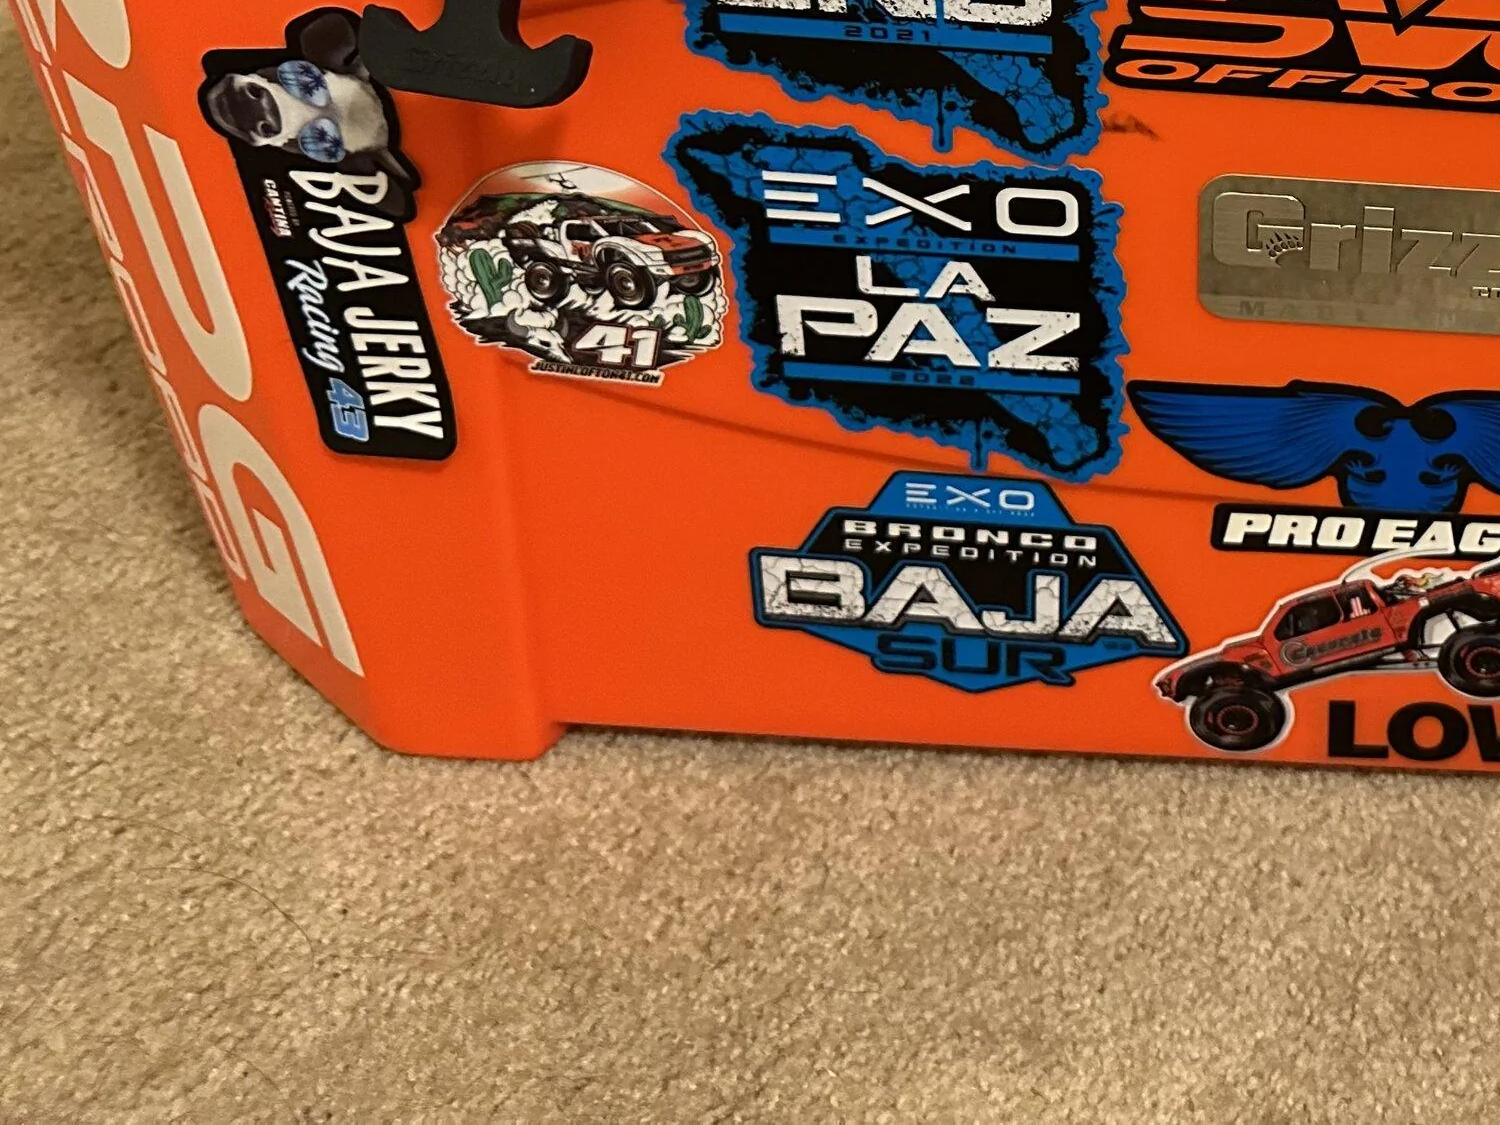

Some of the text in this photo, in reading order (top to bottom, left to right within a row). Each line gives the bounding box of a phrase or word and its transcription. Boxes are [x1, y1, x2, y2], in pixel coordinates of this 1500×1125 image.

[843, 24, 933, 44] 2021
[262, 178, 292, 237] CANTINA
[761, 169, 1080, 238] EXO
[831, 233, 1017, 256] EXPEDITION
[287, 169, 445, 440] BAJA JERKY
[855, 255, 997, 303] LA
[284, 259, 346, 374] Racing
[775, 294, 1081, 373] PAZ
[573, 324, 660, 367] 41
[326, 376, 370, 442] 43
[905, 481, 1035, 511] EXO
[842, 518, 1099, 551] BRONCO
[843, 538, 1098, 568] EXPEDITION
[1222, 512, 1366, 551] PRO
[759, 554, 1179, 649] BAJA
[875, 632, 1074, 687] SUR
